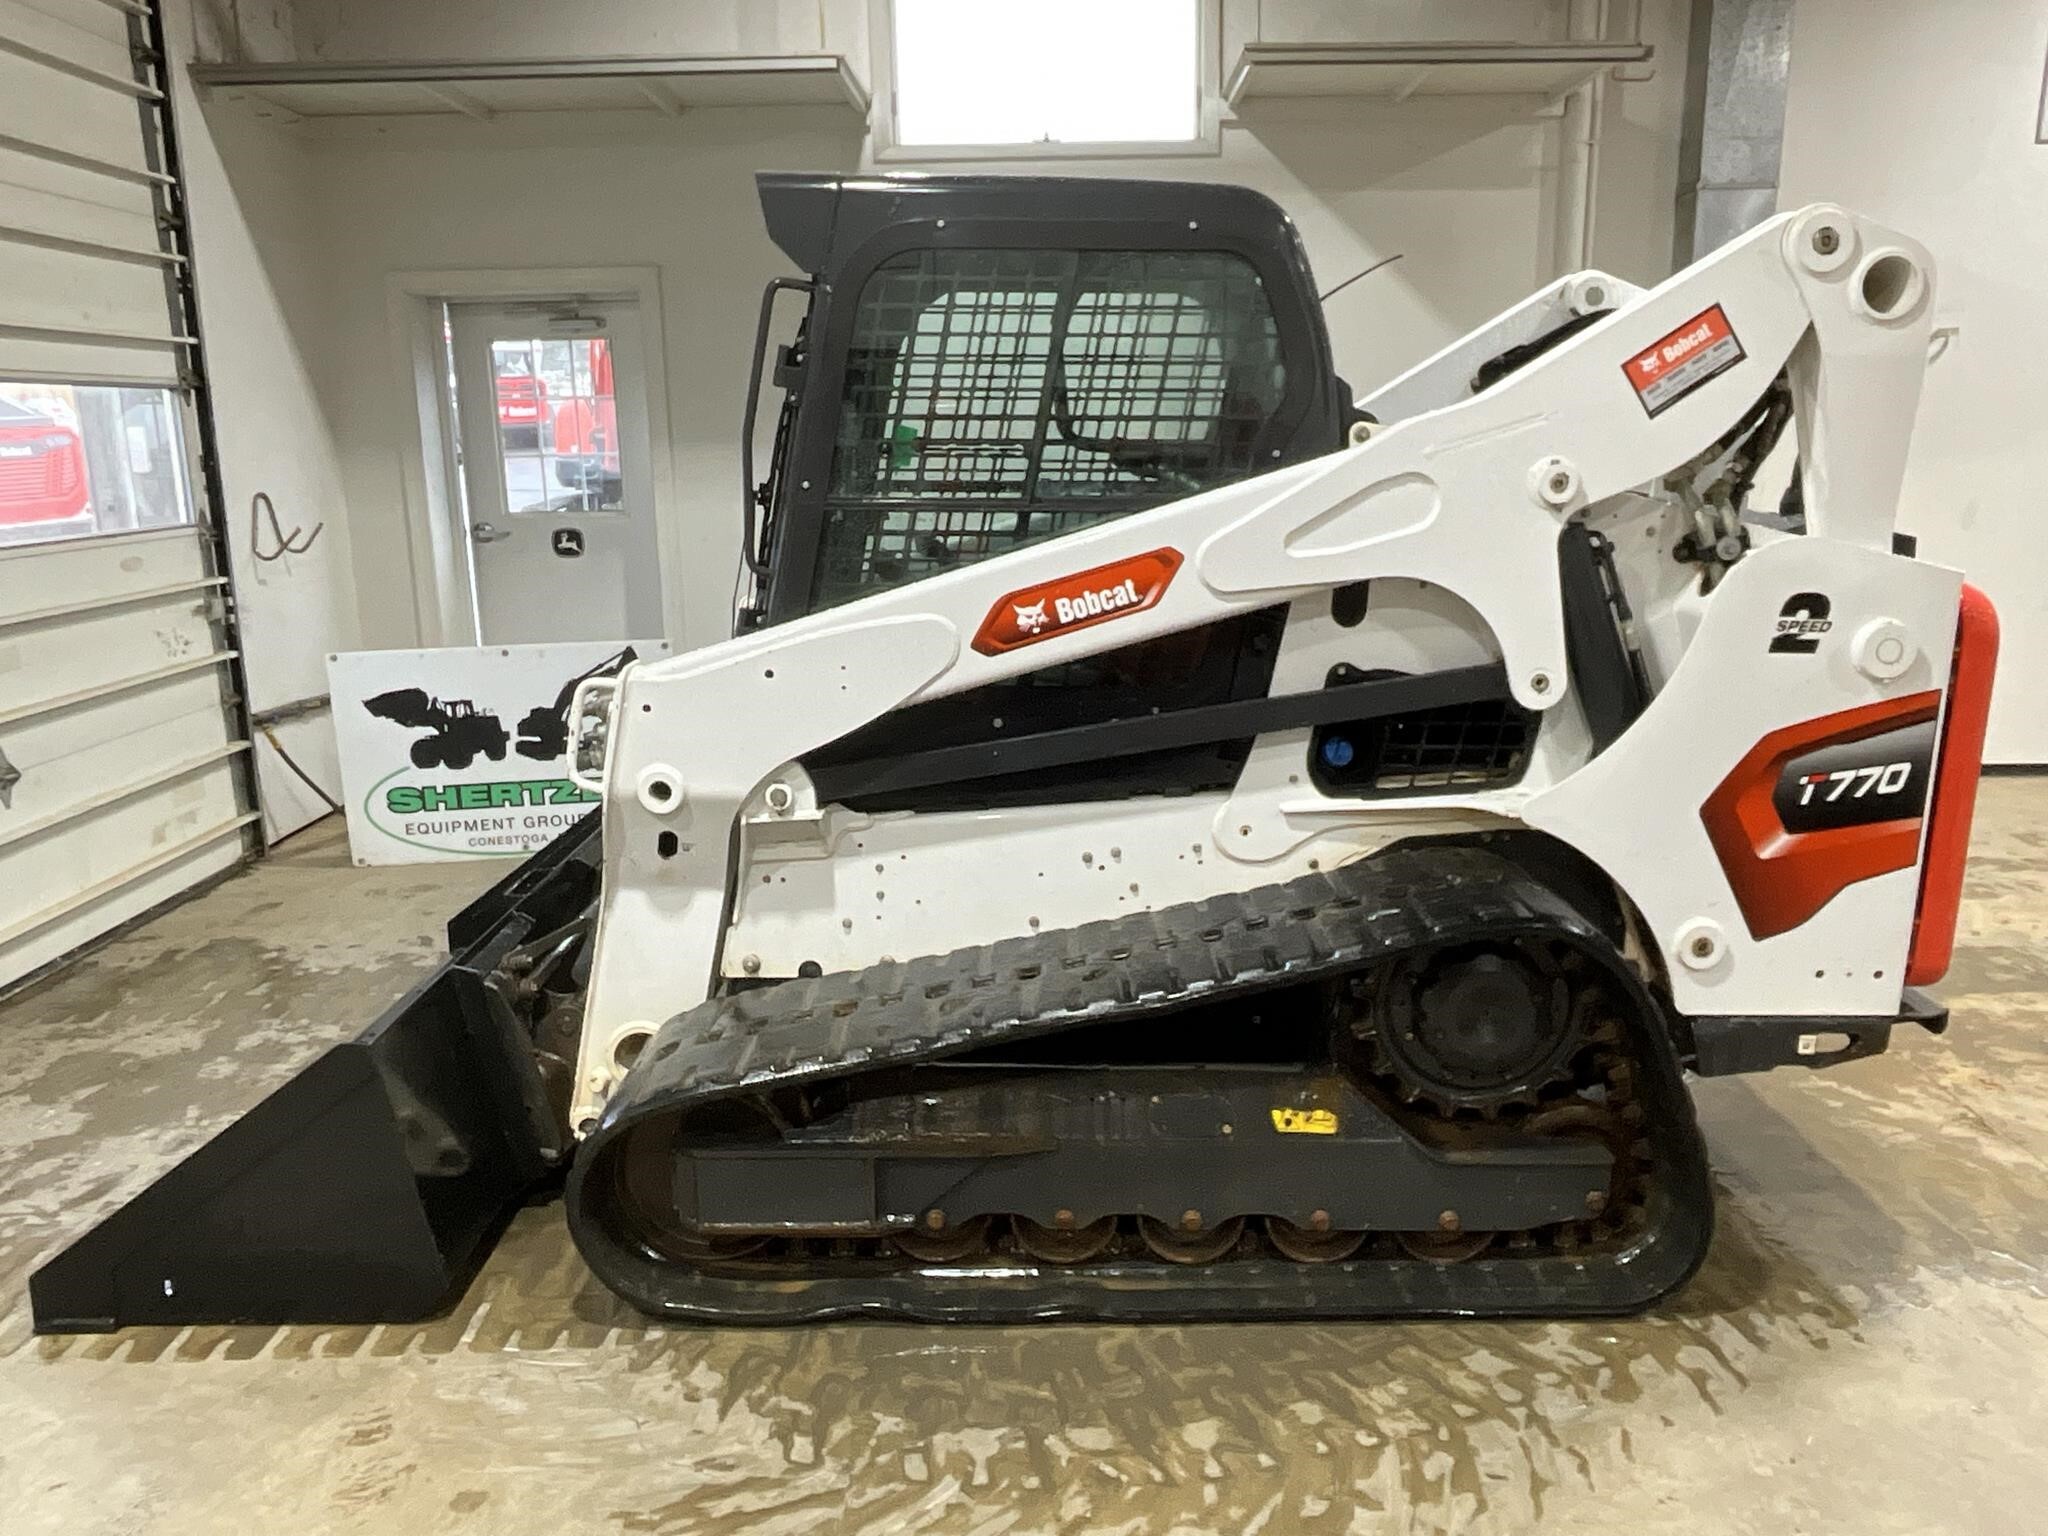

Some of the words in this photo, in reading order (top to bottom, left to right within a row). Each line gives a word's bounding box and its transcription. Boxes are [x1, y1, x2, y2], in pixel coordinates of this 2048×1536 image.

[1662, 322, 1713, 363] Bobcat
[1054, 578, 1139, 625] Bobcat
[1768, 592, 1831, 654] 2
[1776, 620, 1833, 633] SPEED
[1799, 761, 1913, 806] T770
[405, 816, 515, 836] EQUIPMENT
[468, 833, 549, 847] CONESTOGA
